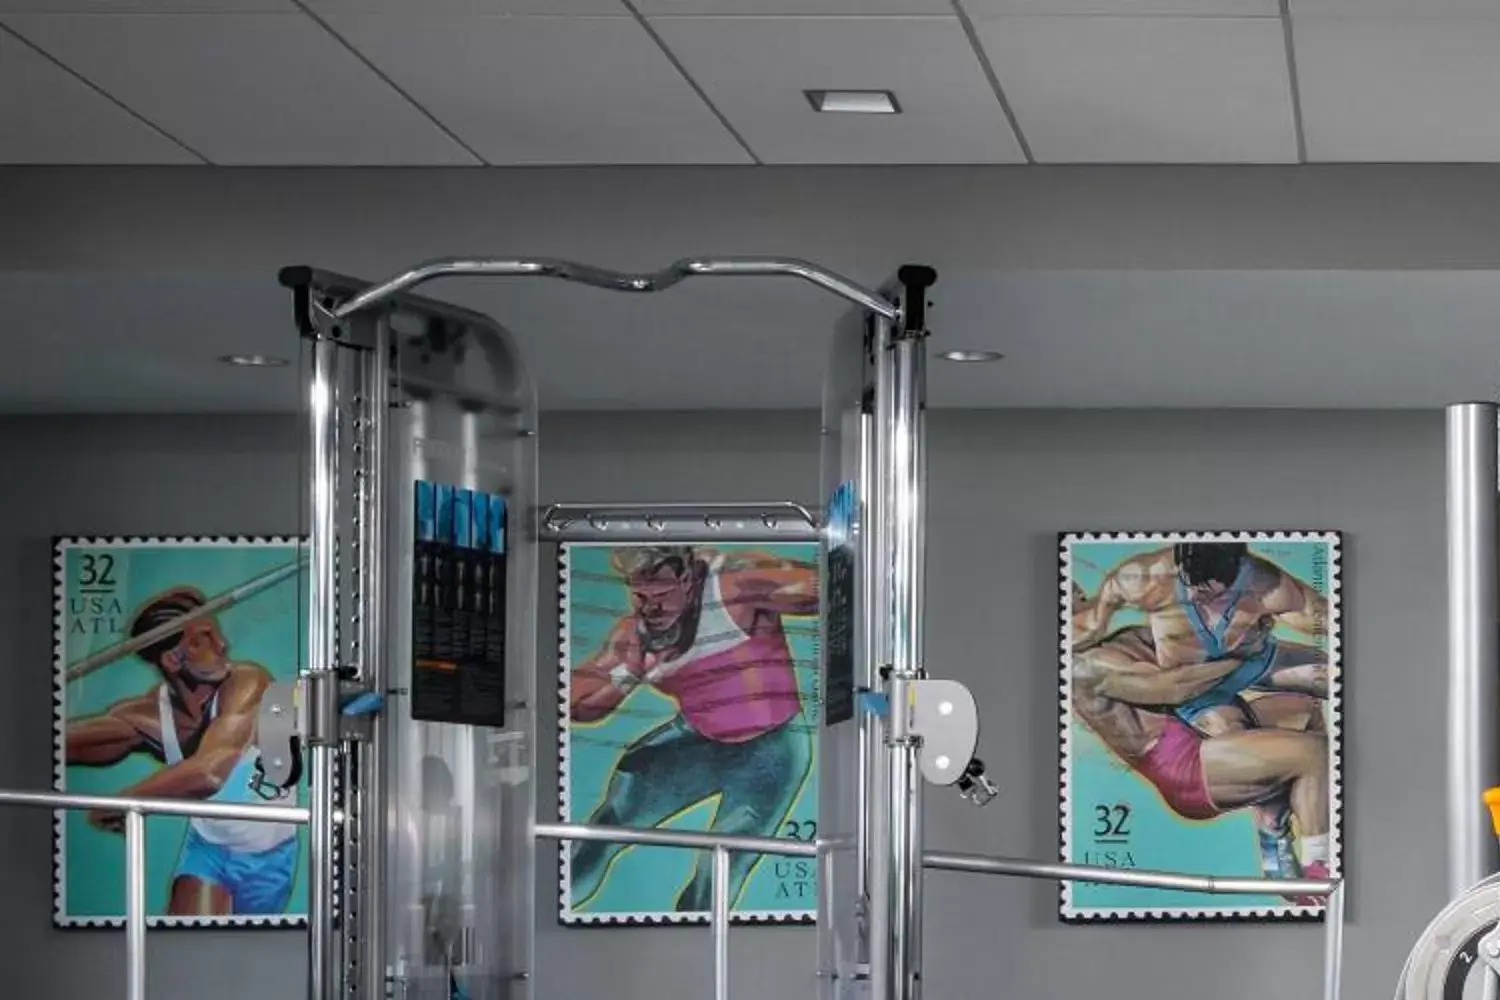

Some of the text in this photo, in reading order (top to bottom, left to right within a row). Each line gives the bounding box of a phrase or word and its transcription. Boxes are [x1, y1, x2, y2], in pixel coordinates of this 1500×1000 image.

[79, 553, 116, 586] 32
[70, 597, 123, 615] USA
[70, 616, 124, 635] ATL
[1093, 804, 1131, 837] 32
[1083, 851, 1137, 868] USA
[774, 861, 817, 879] US
[774, 881, 817, 898] AT
